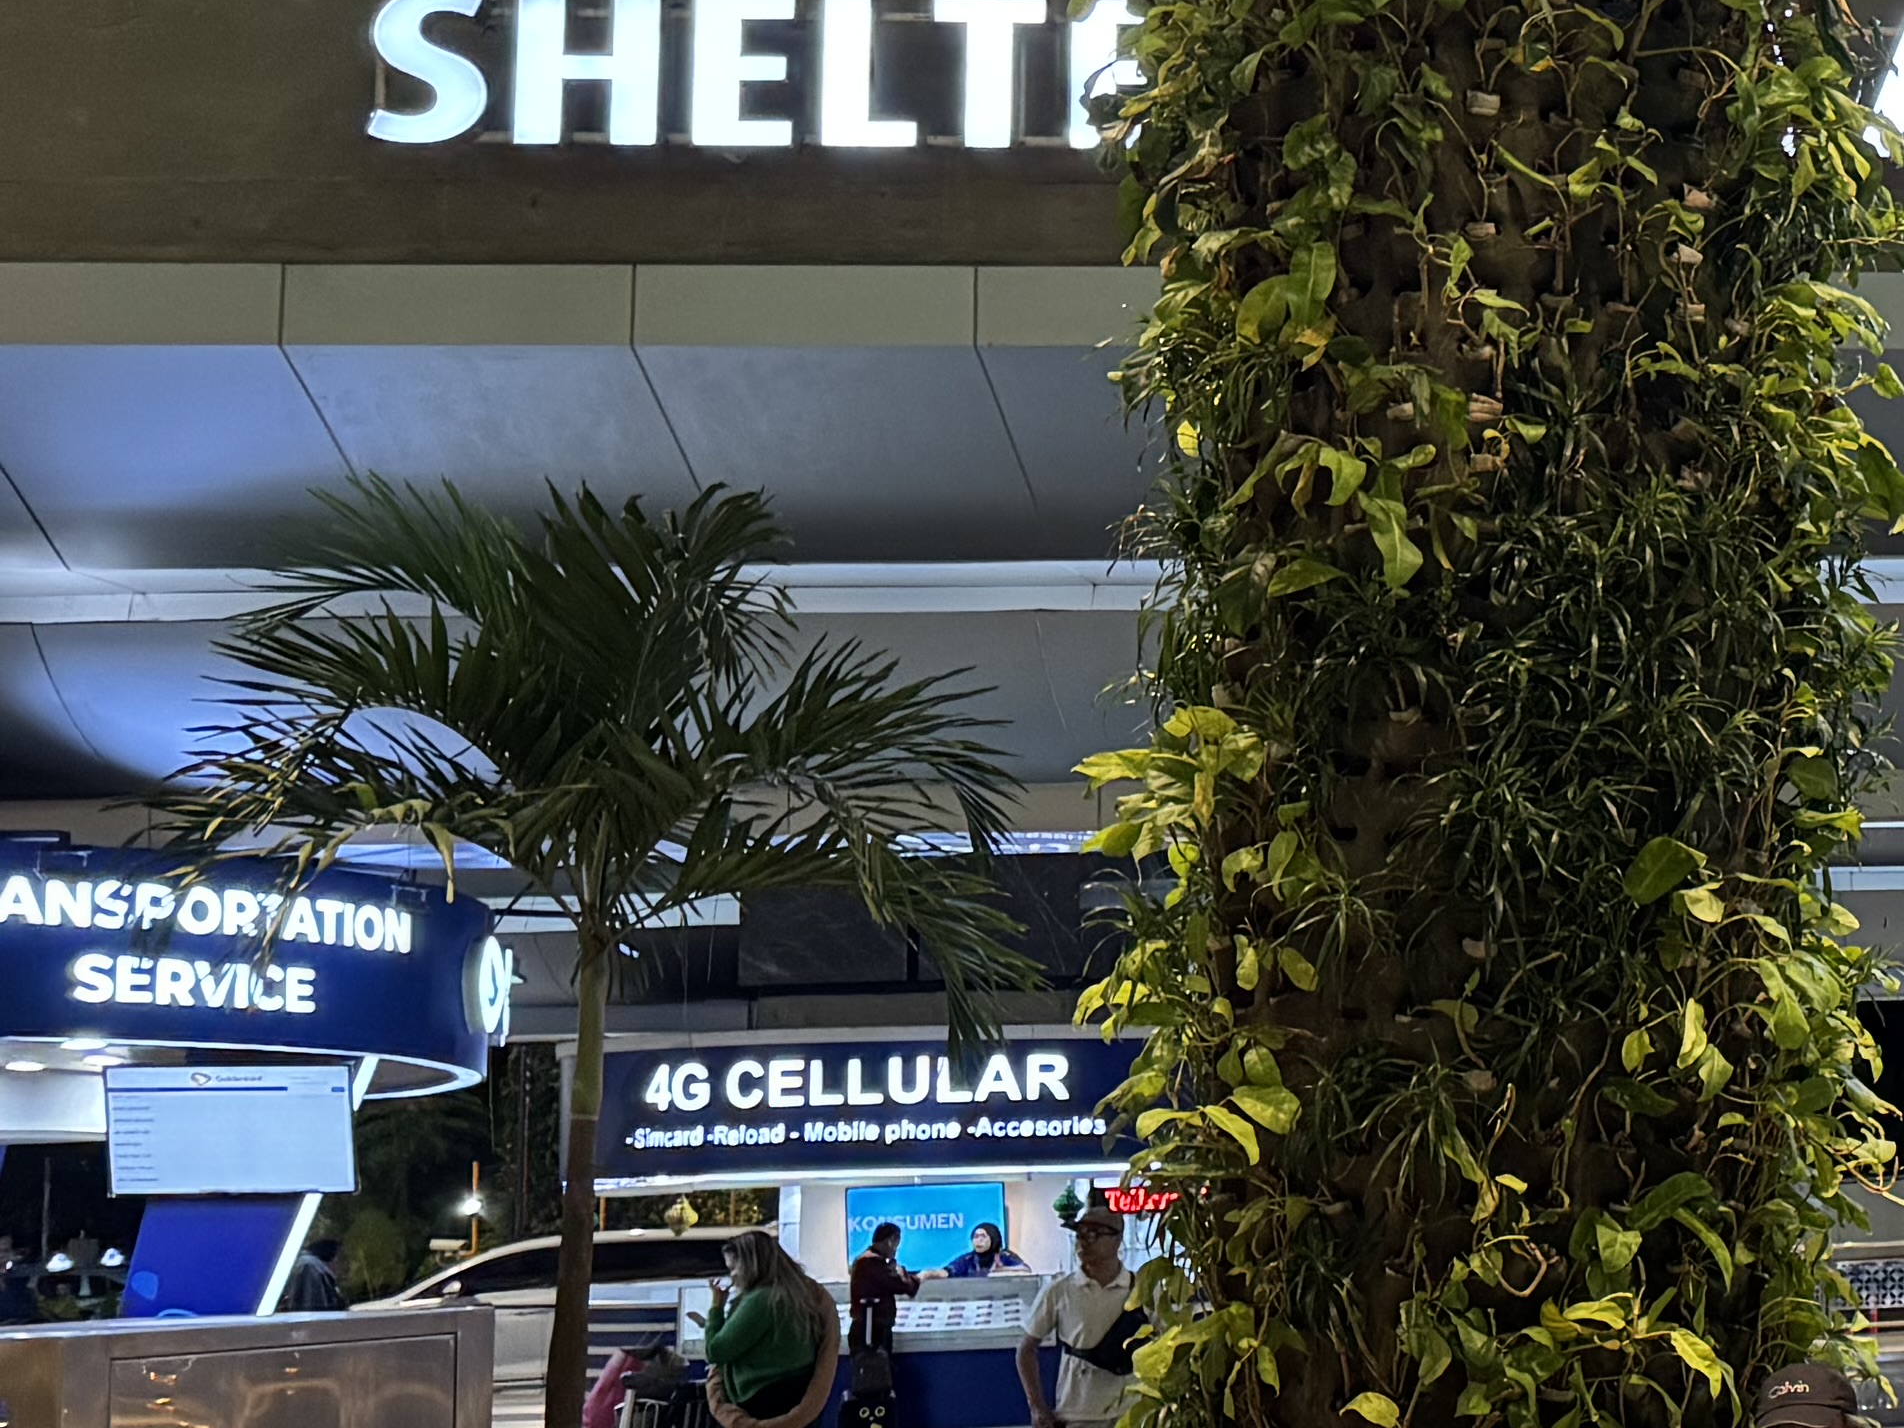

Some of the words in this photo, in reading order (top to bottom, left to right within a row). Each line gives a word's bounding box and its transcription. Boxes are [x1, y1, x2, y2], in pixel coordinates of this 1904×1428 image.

[0, 874, 412, 955] ANSPORTATION
[72, 952, 317, 1015] SERVICE
[644, 1062, 711, 1112] 4G
[725, 1052, 1070, 1110] CELLULAR
[803, 1120, 881, 1142] Mobile
[884, 1118, 962, 1145] phone
